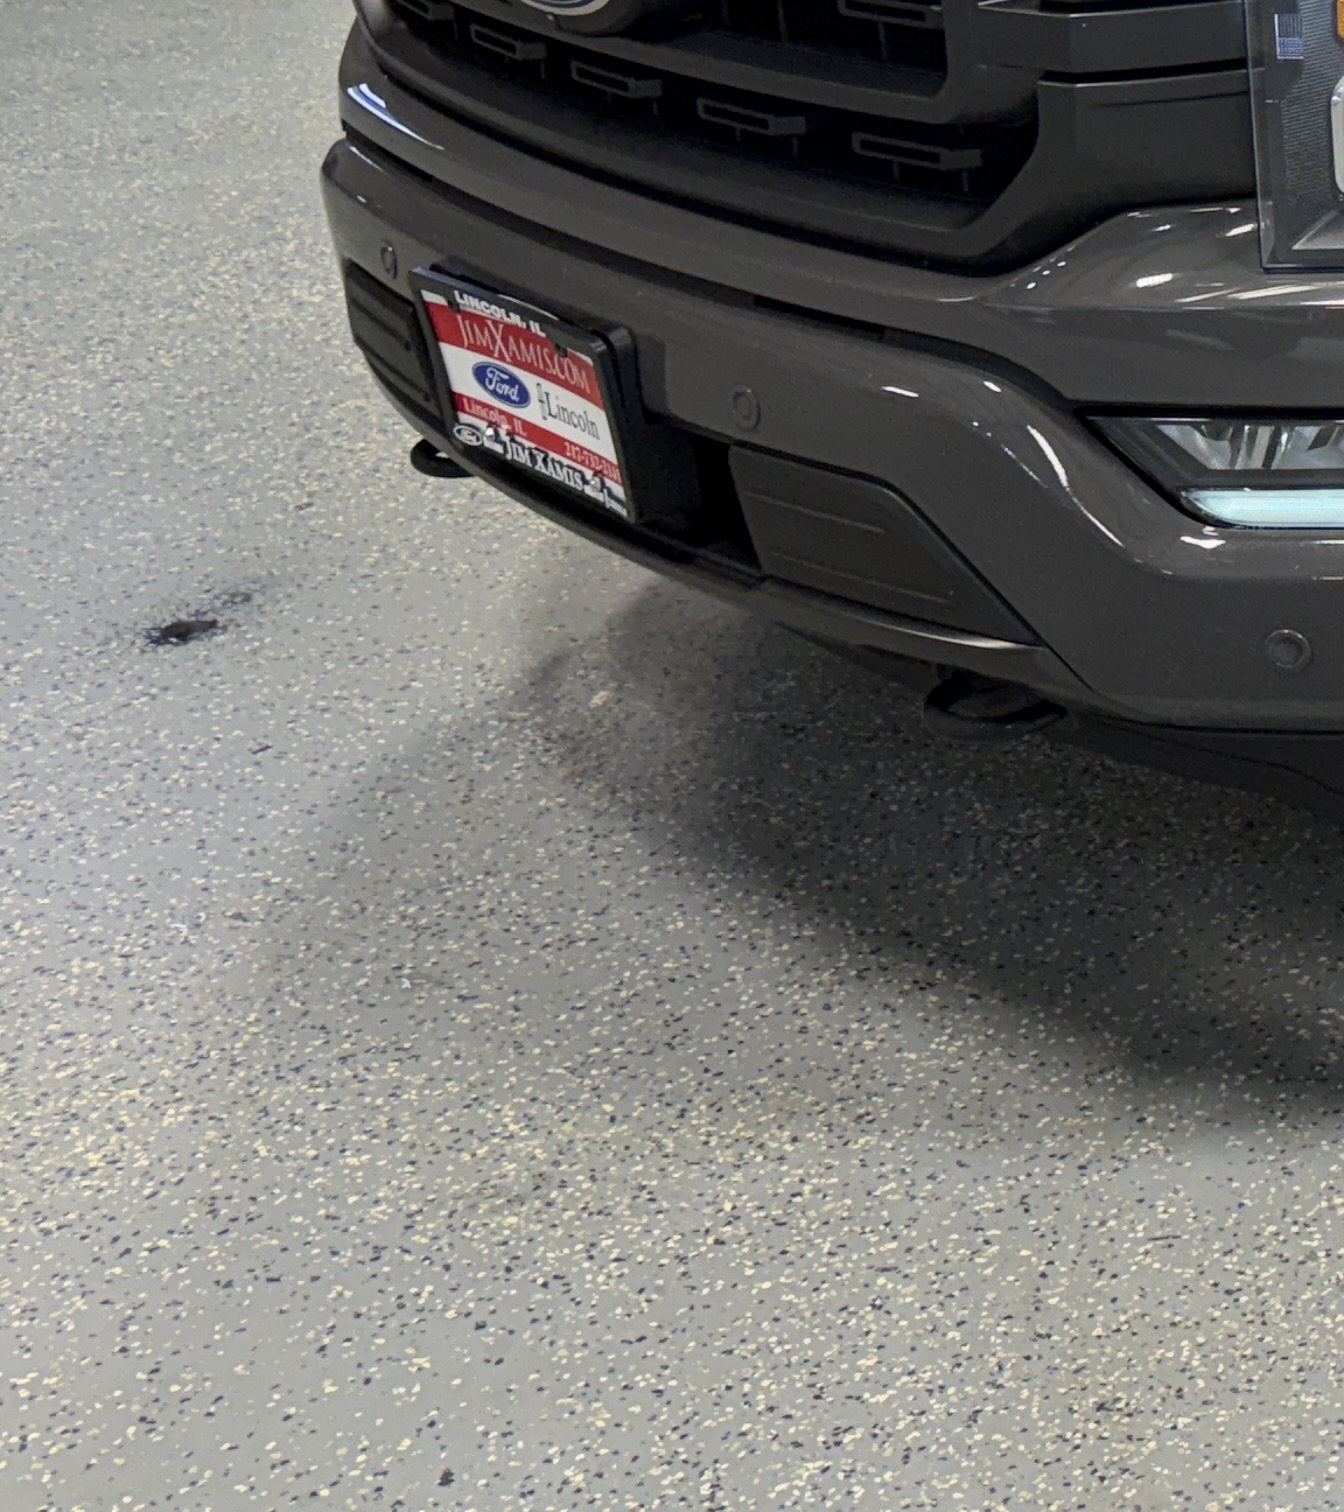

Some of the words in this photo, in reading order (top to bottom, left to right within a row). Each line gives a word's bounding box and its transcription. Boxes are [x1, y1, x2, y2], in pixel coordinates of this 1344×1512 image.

[454, 290, 528, 330] LINCOLN,
[484, 366, 521, 403] Ford
[546, 390, 601, 441] Lincoln
